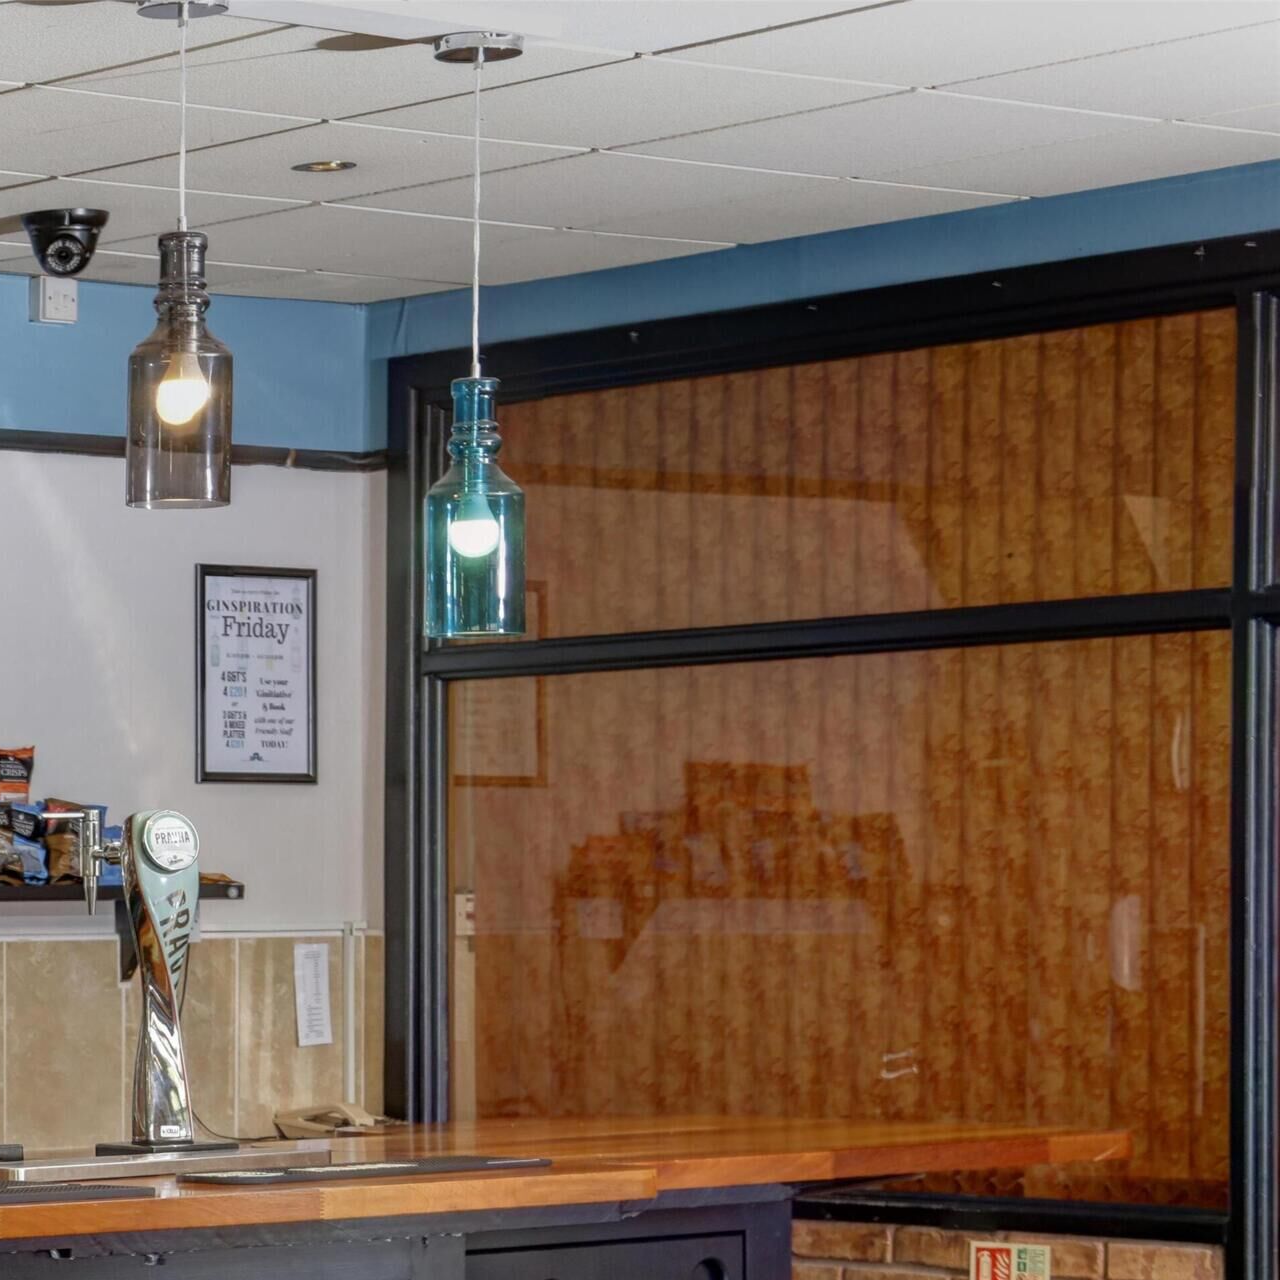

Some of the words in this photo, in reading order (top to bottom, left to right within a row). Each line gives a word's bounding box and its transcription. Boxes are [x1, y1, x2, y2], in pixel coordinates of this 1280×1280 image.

[207, 599, 303, 614] GINSPIRATION
[221, 615, 290, 645] Friday
[223, 730, 246, 738] PLATTER
